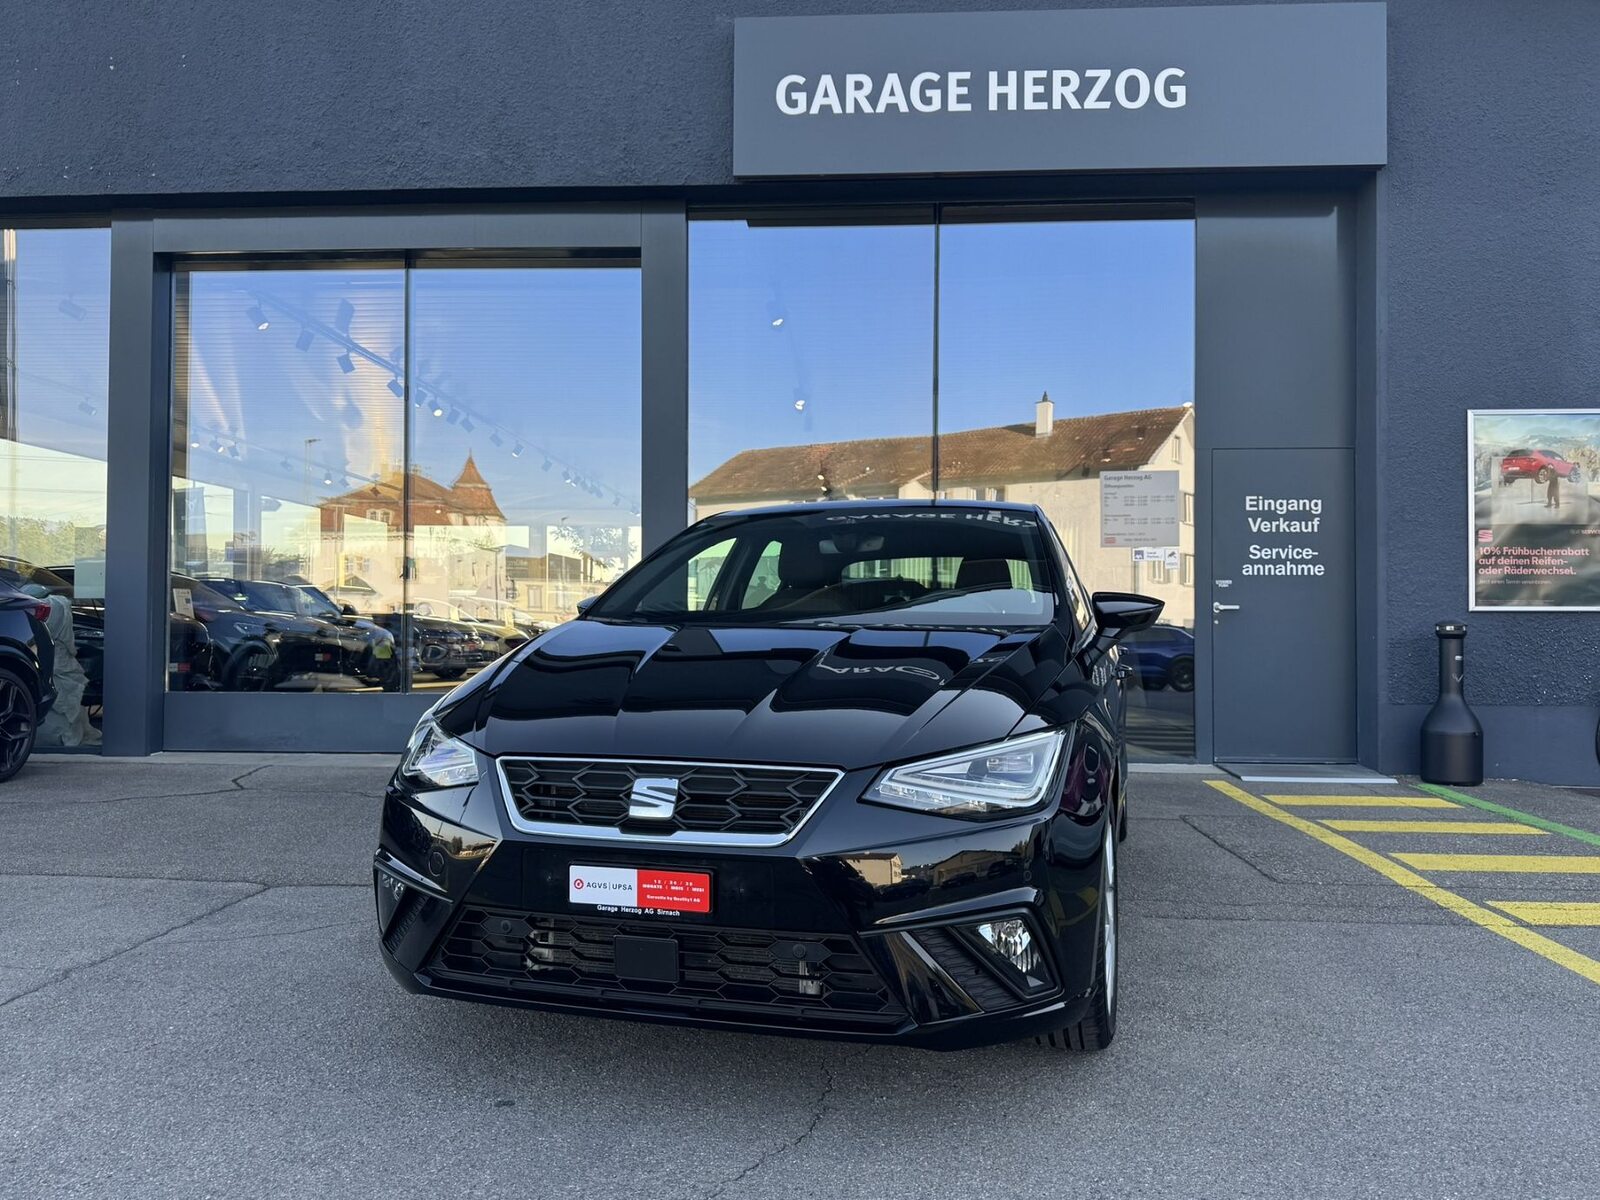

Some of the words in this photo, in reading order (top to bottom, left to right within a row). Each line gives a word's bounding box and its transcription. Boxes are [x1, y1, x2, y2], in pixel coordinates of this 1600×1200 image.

[775, 71, 972, 116] GARAGE
[988, 67, 1187, 112] HERZOG
[1245, 495, 1322, 515] Eingang
[1247, 517, 1321, 533] Verkauf
[1248, 544, 1319, 560] Service-
[1479, 546, 1501, 556] 10%
[1503, 546, 1590, 556] Frühbucherrabatt
[1242, 560, 1326, 576] annahme
[1478, 556, 1496, 565] auf
[1497, 556, 1530, 565] deinen
[1531, 556, 1569, 565] Reifen-
[1478, 566, 1503, 575] oder
[1504, 565, 1577, 575] Räderwechsel.
[597, 904, 618, 912] Garage
[620, 906, 642, 915] Herzog
[657, 909, 680, 917] Sirnach
